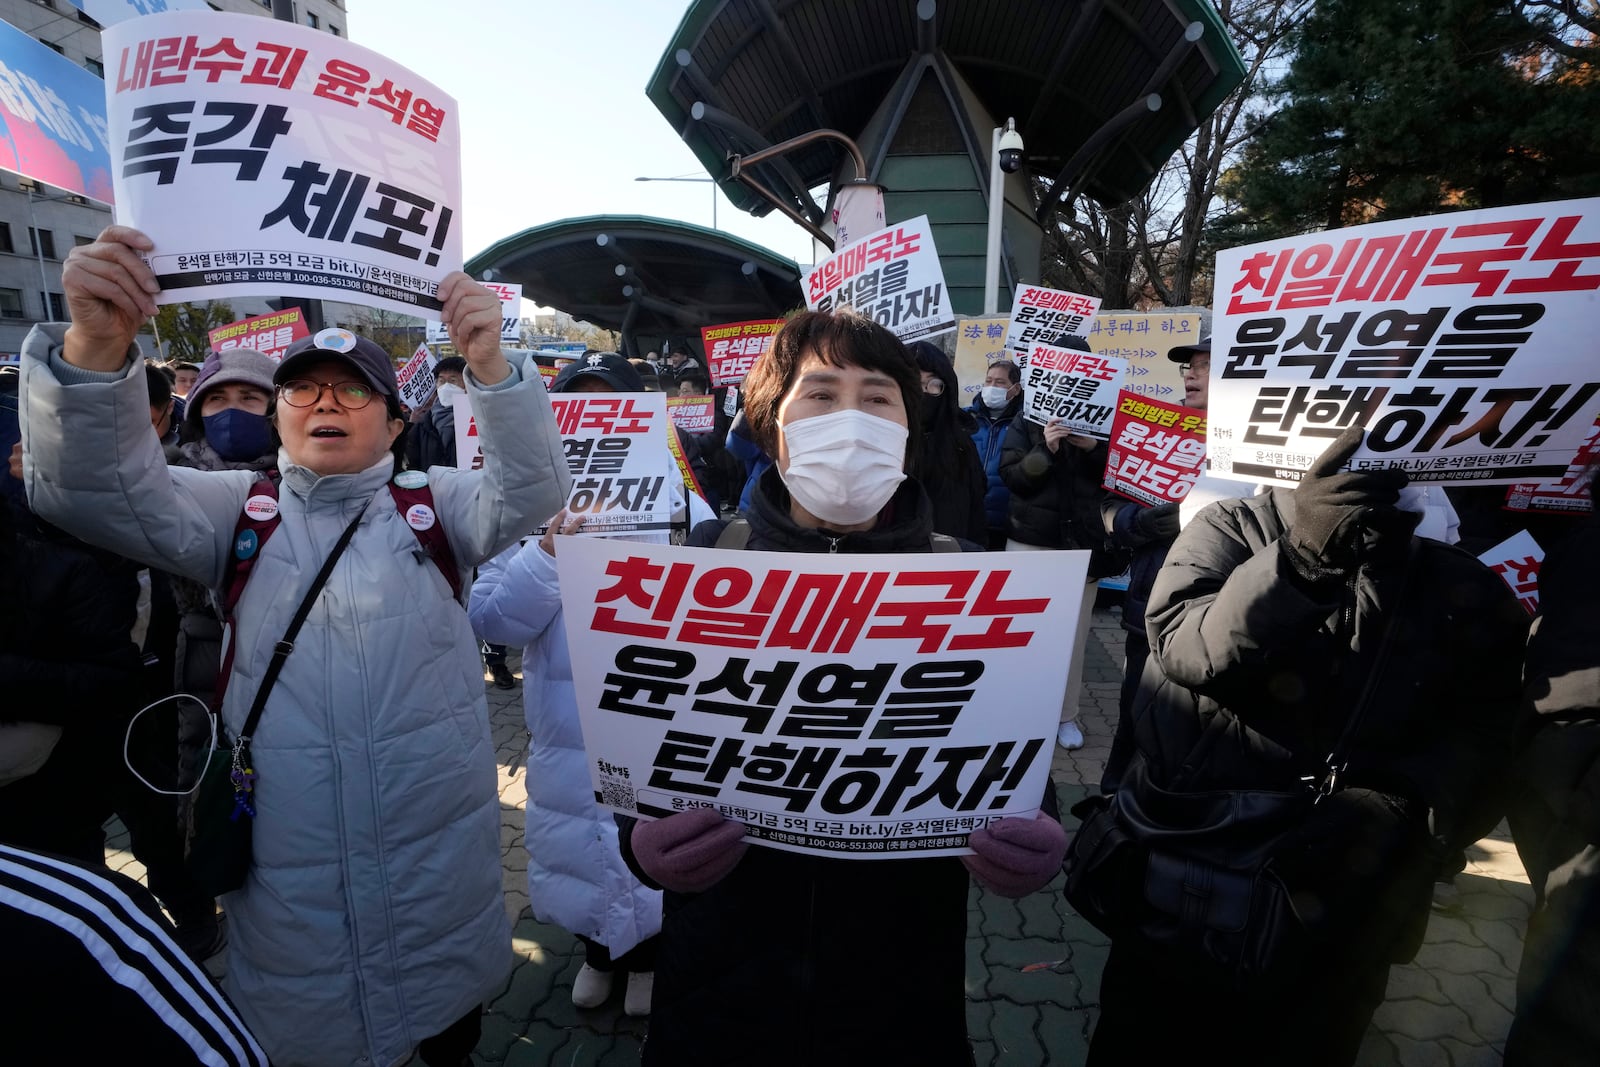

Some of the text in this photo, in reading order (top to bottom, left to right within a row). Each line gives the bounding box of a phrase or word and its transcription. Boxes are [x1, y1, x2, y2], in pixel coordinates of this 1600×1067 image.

[115, 35, 446, 143] 내란수괴 윤석열
[122, 100, 293, 186] 즉각
[259, 160, 453, 266] 체포!
[177, 253, 211, 270] 윤석열
[214, 251, 265, 267] 탄핵기금
[269, 252, 292, 267] 5억
[297, 254, 325, 270] 모금
[808, 227, 921, 304] 친일매국노
[1226, 214, 1600, 316] 친일매국노
[203, 271, 232, 284] 탄핵기금
[233, 271, 250, 281] 모금
[257, 271, 291, 282] 신한은행
[293, 273, 361, 290] 100-036-551308
[1014, 306, 1084, 333] 윤석열을
[1019, 288, 1096, 317] 친일매국노
[250, 311, 299, 331] 우크라개입
[1160, 318, 1191, 334] 하오
[1222, 303, 1546, 380] 윤석열을
[719, 356, 761, 377] 타도
[1030, 346, 1118, 381] 친일매국노
[1028, 368, 1101, 401] 윤석열을
[1031, 391, 1115, 426] 탄핵하자!
[1118, 397, 1182, 428] 건희방탄
[1243, 381, 1600, 454] 탄핵하자!
[1116, 421, 1207, 470] 윤석열
[1255, 450, 1283, 465] 윤석열
[1389, 452, 1537, 471] bit.ly/윤석열탄핵기금
[590, 556, 1051, 655] 친일매국노
[598, 644, 985, 741] 윤석열을
[647, 730, 1046, 817] 탄핵하자!
[719, 804, 779, 828] 탄핵기금
[783, 817, 808, 833] 5억
[813, 819, 844, 836] 모금
[769, 830, 805, 845] 신한은행
[808, 837, 884, 851] 100-036-551308
